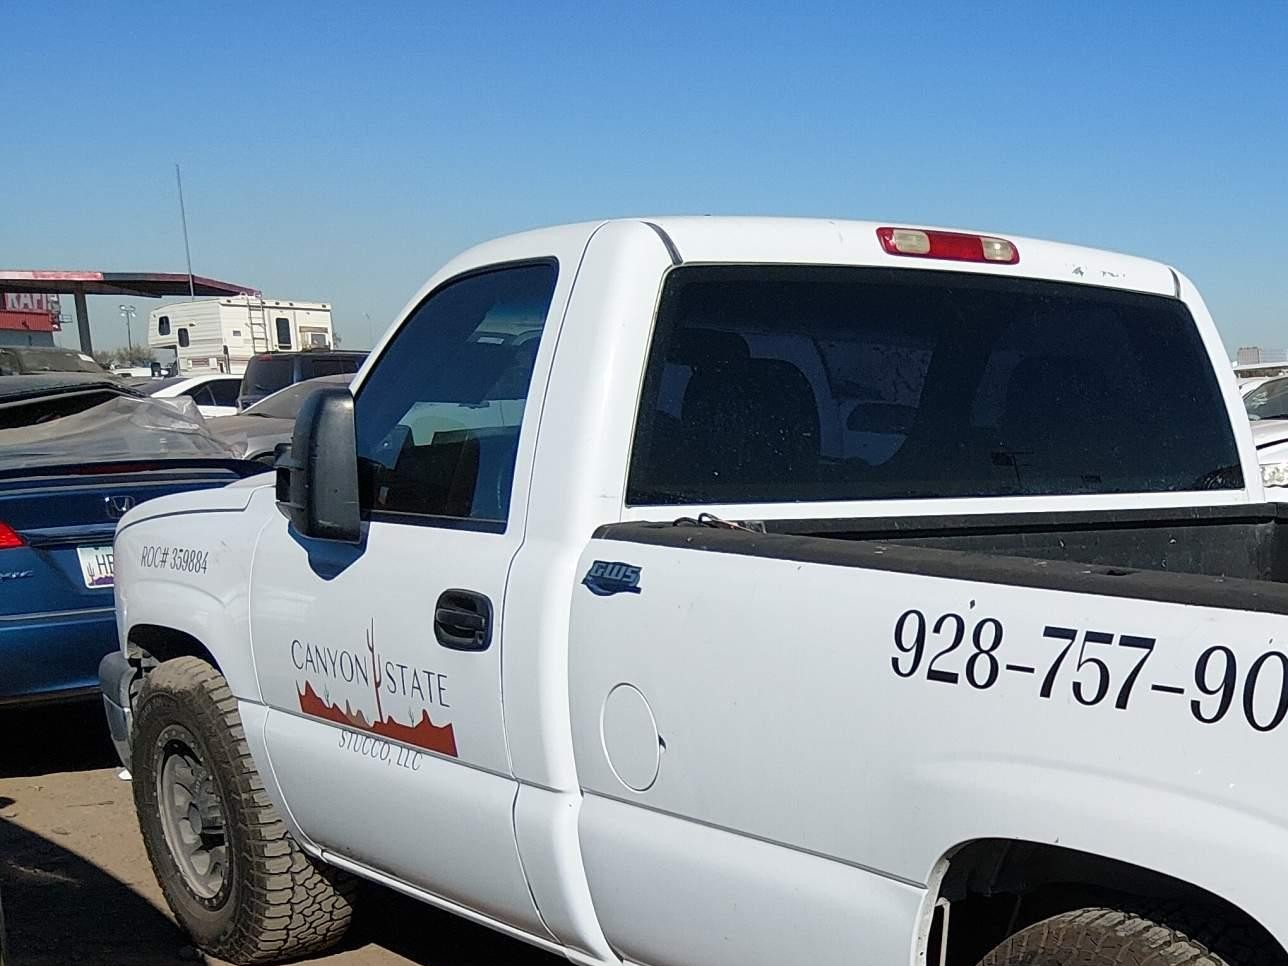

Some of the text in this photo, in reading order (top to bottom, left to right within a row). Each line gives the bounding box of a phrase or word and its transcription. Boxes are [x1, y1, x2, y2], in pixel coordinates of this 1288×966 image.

[170, 548, 209, 574] 359884
[291, 640, 450, 708] CANYON STATE
[397, 747, 423, 771] LLC
